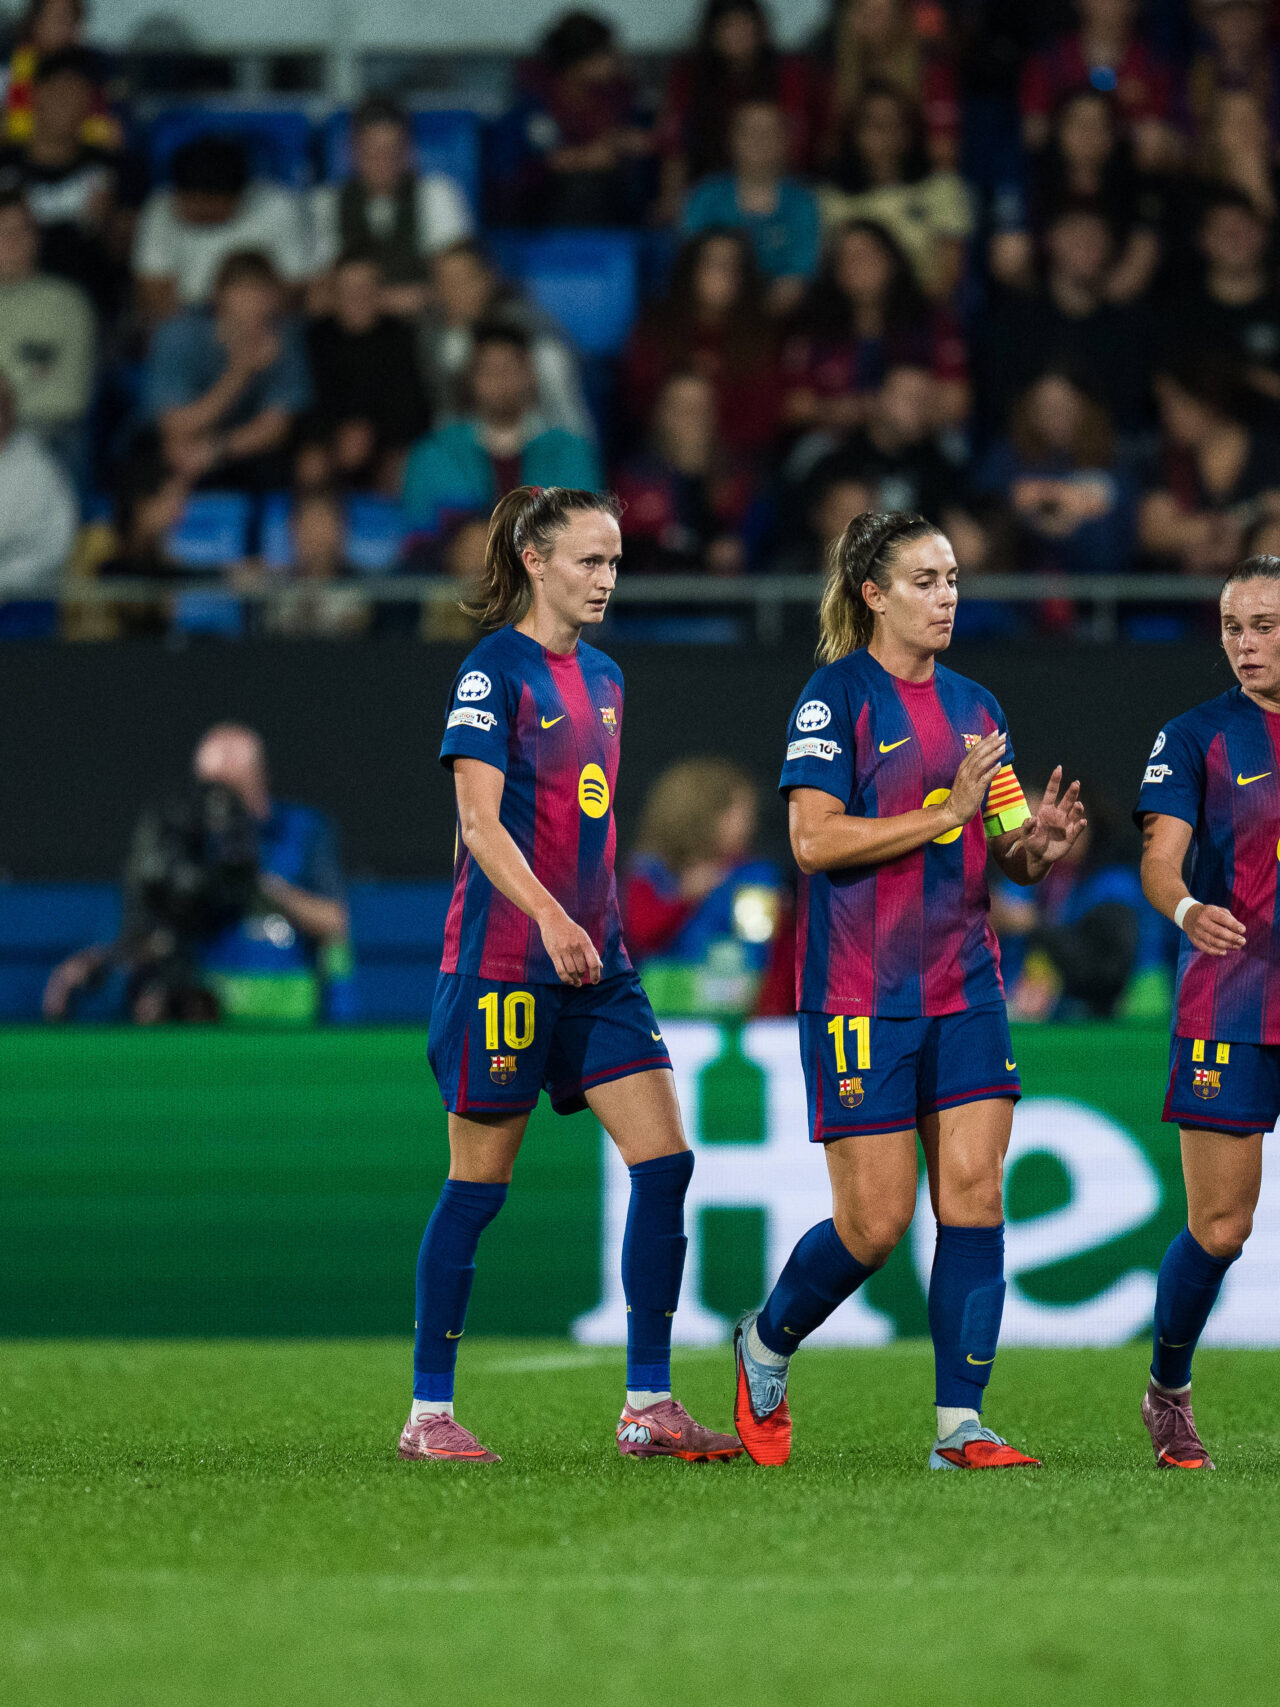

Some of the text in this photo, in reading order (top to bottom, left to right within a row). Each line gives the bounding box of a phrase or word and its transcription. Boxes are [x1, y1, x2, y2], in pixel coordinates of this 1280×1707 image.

[476, 713, 490, 725] 10
[819, 743, 833, 754] 10
[1150, 769, 1163, 778] 10
[478, 991, 536, 1050] 10
[827, 1015, 871, 1073] 11
